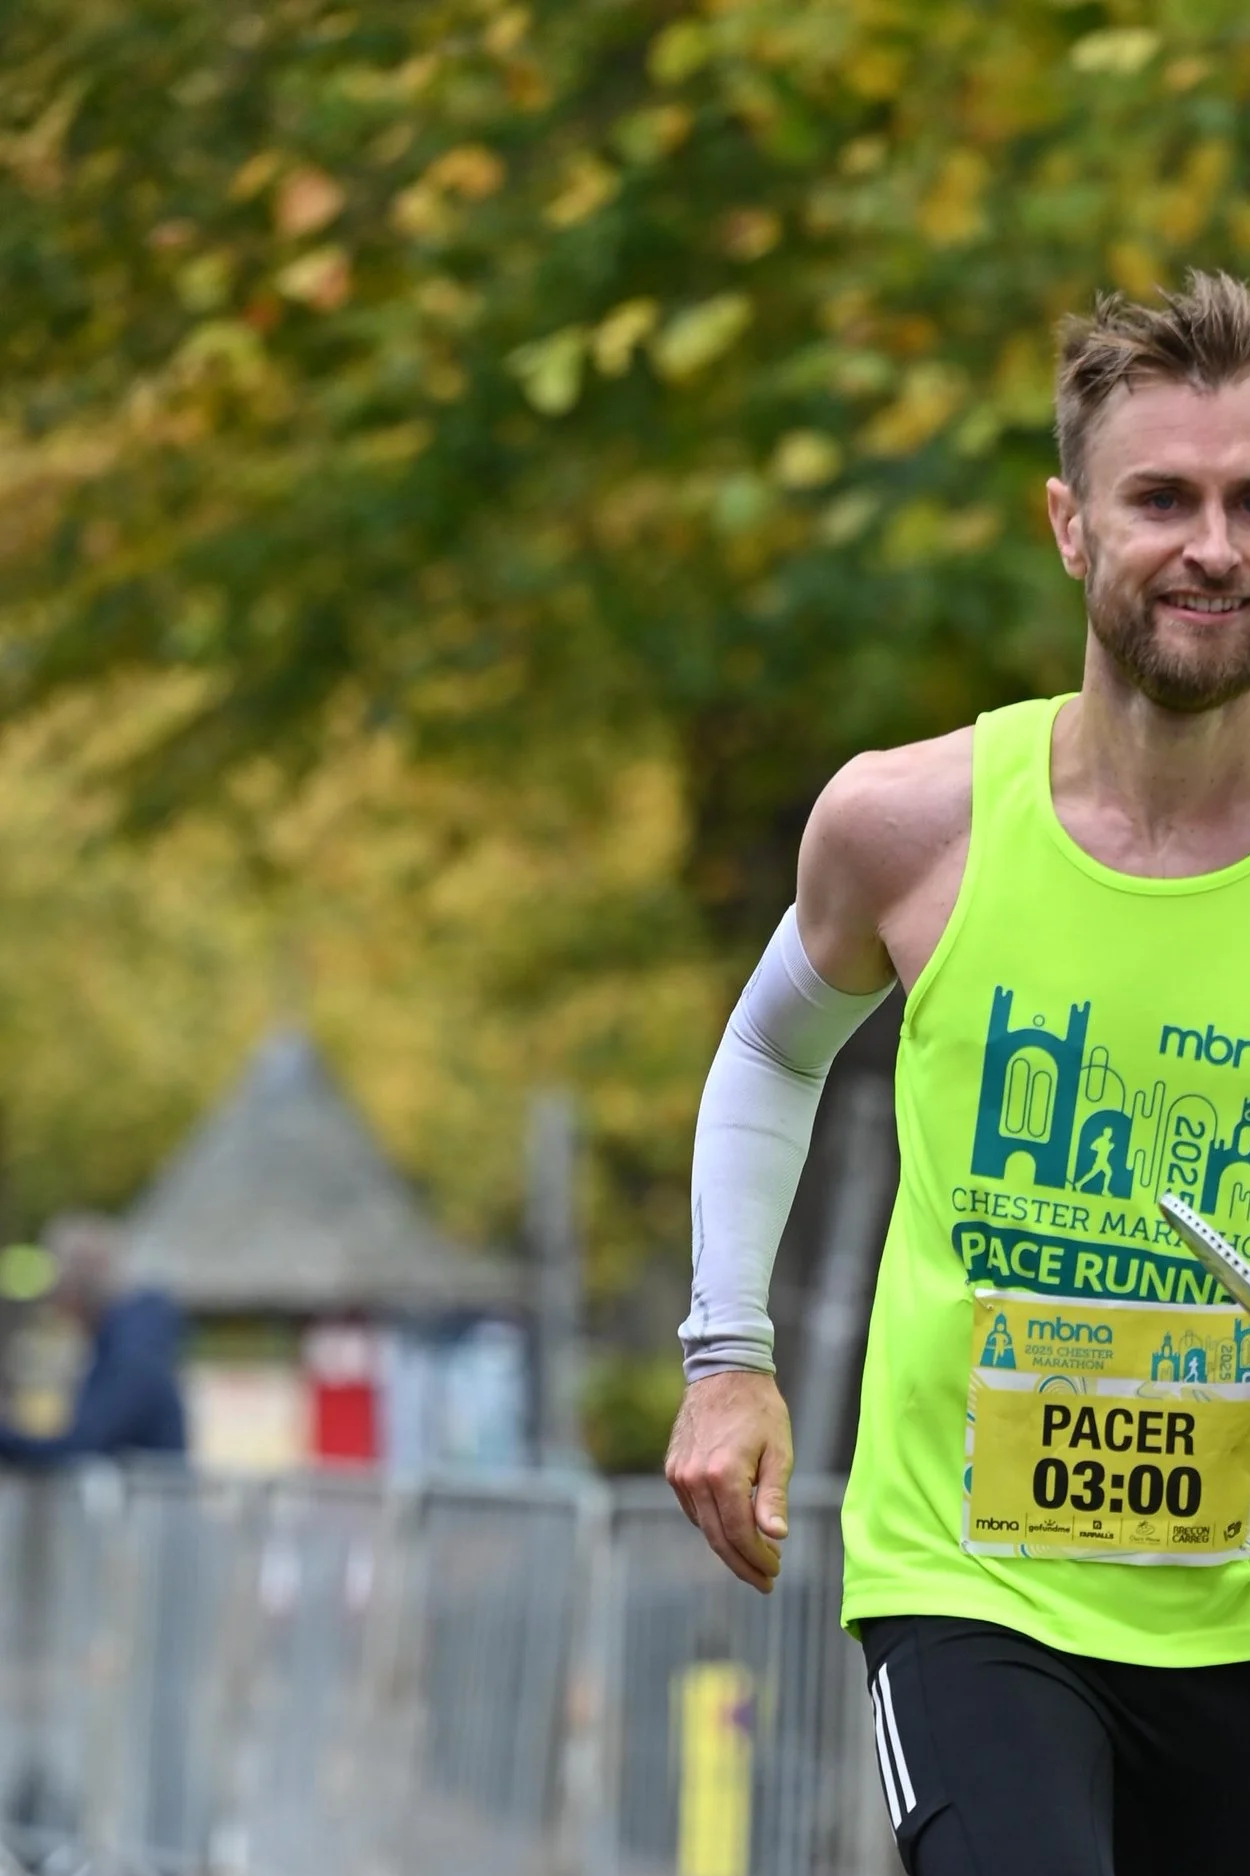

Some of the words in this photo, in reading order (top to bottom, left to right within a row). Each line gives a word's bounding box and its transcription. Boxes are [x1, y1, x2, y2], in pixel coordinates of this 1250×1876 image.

[952, 1187, 1090, 1232] CHESTER
[960, 1231, 1065, 1286] PACE
[1073, 1251, 1233, 1304] RUNN
[1027, 1316, 1113, 1344] mbna
[1024, 1344, 1053, 1356] 2025
[1056, 1347, 1113, 1359] CHESTER
[1032, 1357, 1104, 1370] MARATHON
[1219, 1344, 1233, 1381] 2025
[1041, 1404, 1196, 1456] PACER
[1032, 1457, 1203, 1518] 03:00
[976, 1517, 1020, 1531] mbna
[1171, 1534, 1210, 1543] CARREG
